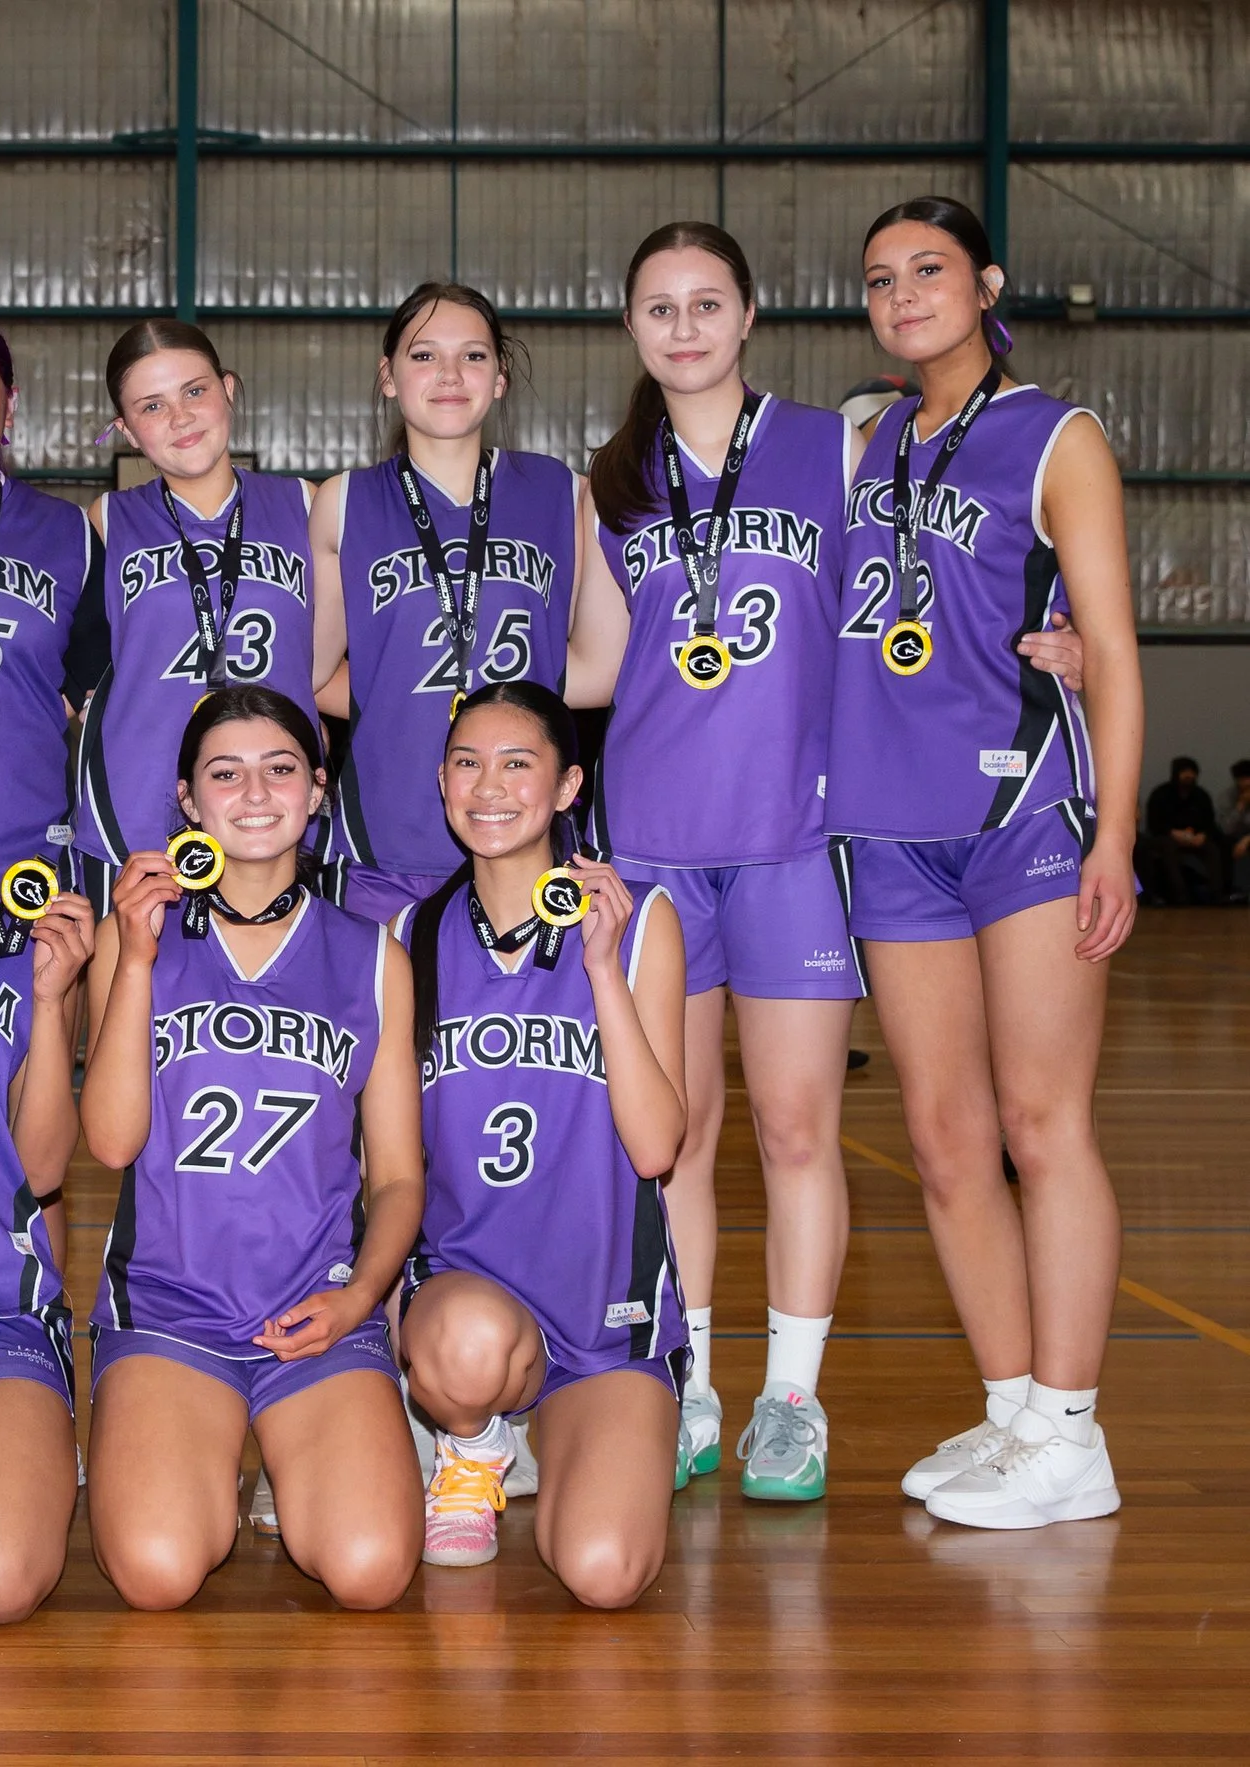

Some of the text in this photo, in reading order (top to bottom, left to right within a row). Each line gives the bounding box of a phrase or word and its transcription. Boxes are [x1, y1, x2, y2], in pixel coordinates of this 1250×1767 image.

[961, 391, 986, 427] PACERS
[735, 413, 751, 450] PACERS
[402, 470, 420, 506] PACERS
[479, 466, 488, 502] PACERS
[668, 454, 680, 488] PACERS
[622, 507, 823, 597] STORM
[710, 515, 722, 556] PACERS
[121, 539, 306, 615] STORM
[368, 538, 556, 616] STORM
[437, 572, 452, 613] PACERS
[467, 571, 477, 613] PACERS
[686, 554, 701, 594] PACER
[159, 608, 277, 684] 43
[201, 611, 215, 651] PACERS
[411, 608, 532, 694] 25
[478, 922, 494, 947] PACE
[545, 926, 560, 957] ACERS
[174, 1085, 321, 1175] 27
[478, 1101, 538, 1188] 3
